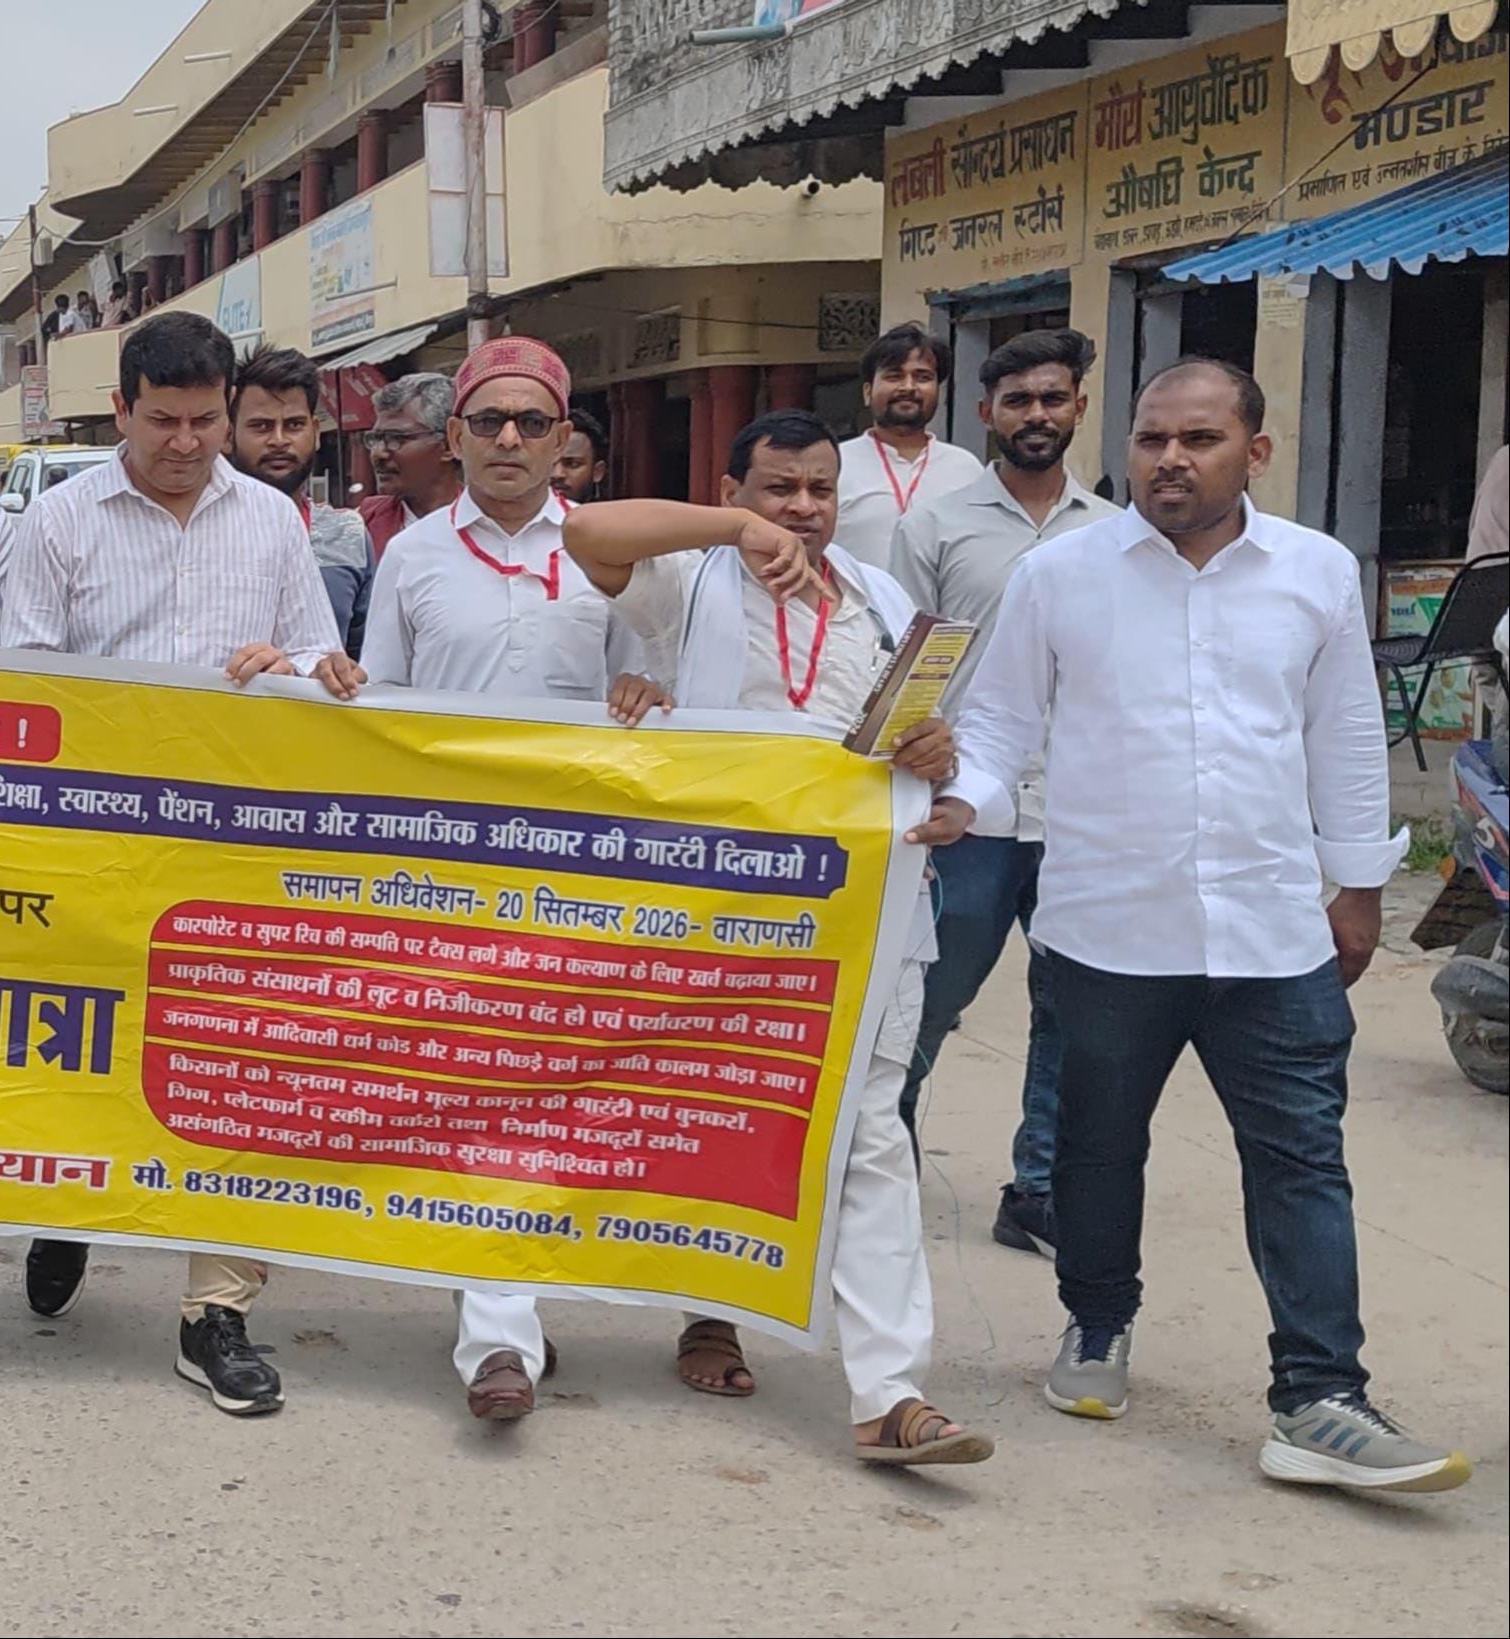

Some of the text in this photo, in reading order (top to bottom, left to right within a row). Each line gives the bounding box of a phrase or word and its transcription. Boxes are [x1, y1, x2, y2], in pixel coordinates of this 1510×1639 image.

[59, 786, 149, 823] स्वास्थ्य,
[159, 788, 221, 831] पेंशन,
[231, 804, 306, 834] आवास
[313, 802, 359, 837] और
[366, 810, 478, 845] सामाजिक
[485, 817, 585, 858] अधिकार
[591, 827, 627, 862] की
[634, 835, 706, 871] गारंटी
[282, 871, 363, 903] समापन
[497, 890, 523, 920] 20
[533, 886, 626, 933] सितम्बर
[713, 912, 817, 949] वाराणसी
[173, 914, 237, 936] कारपोरेट
[241, 922, 253, 938] व
[256, 923, 291, 946] सुपर
[295, 923, 321, 945] रिच
[325, 926, 346, 947] की
[403, 937, 425, 955] पर
[429, 937, 465, 961] टैक्स
[468, 944, 498, 964] लगे
[501, 946, 531, 969] और
[534, 953, 562, 973] जन
[566, 957, 627, 979] कल्याण
[630, 960, 647, 980] के
[651, 961, 684, 985] लिए
[169, 963, 246, 986] प्राकृतिक
[252, 966, 332, 996] संसाधनों
[336, 977, 362, 1000] की
[367, 985, 398, 1009] लूट
[404, 989, 419, 1008] व
[424, 986, 523, 1020] निजीकरण
[529, 1001, 558, 1025] बंद
[564, 1003, 586, 1027] हो
[592, 1007, 622, 1030] एवं
[628, 1012, 715, 1032] पर्यावरण
[720, 1013, 750, 1034] की
[163, 1010, 238, 1034] जनगणना
[243, 1017, 258, 1036] में
[263, 1021, 339, 1047] आदिवासी
[343, 1031, 372, 1050] धर्म
[377, 1035, 411, 1053] कोड
[418, 1039, 448, 1060] और
[454, 1046, 491, 1065] अन्य
[547, 1056, 578, 1073] वर्ग
[582, 1059, 605, 1071] का
[610, 1053, 651, 1072] जाति
[655, 1058, 710, 1078] कालम
[169, 1052, 240, 1079] किसानों
[244, 1065, 271, 1083] को
[276, 1070, 347, 1093] न्यूनतम
[351, 1080, 419, 1104] समर्थन
[425, 1091, 470, 1111] मूल्य
[475, 1096, 534, 1111] कानून
[539, 1094, 568, 1110] की
[573, 1096, 634, 1118] गारंटी
[639, 1102, 670, 1121] एवं
[166, 1113, 252, 1138] असंगठित
[257, 1126, 321, 1149] मजदूरों
[327, 1134, 354, 1150] की
[360, 1136, 451, 1156] सामाजिक
[457, 1143, 512, 1165] सुरक्षा
[132, 1159, 172, 1191] मो.
[184, 1171, 373, 1217] 8318223196,
[387, 1194, 582, 1240] 9415605084,
[596, 1216, 784, 1268] 7905645778
